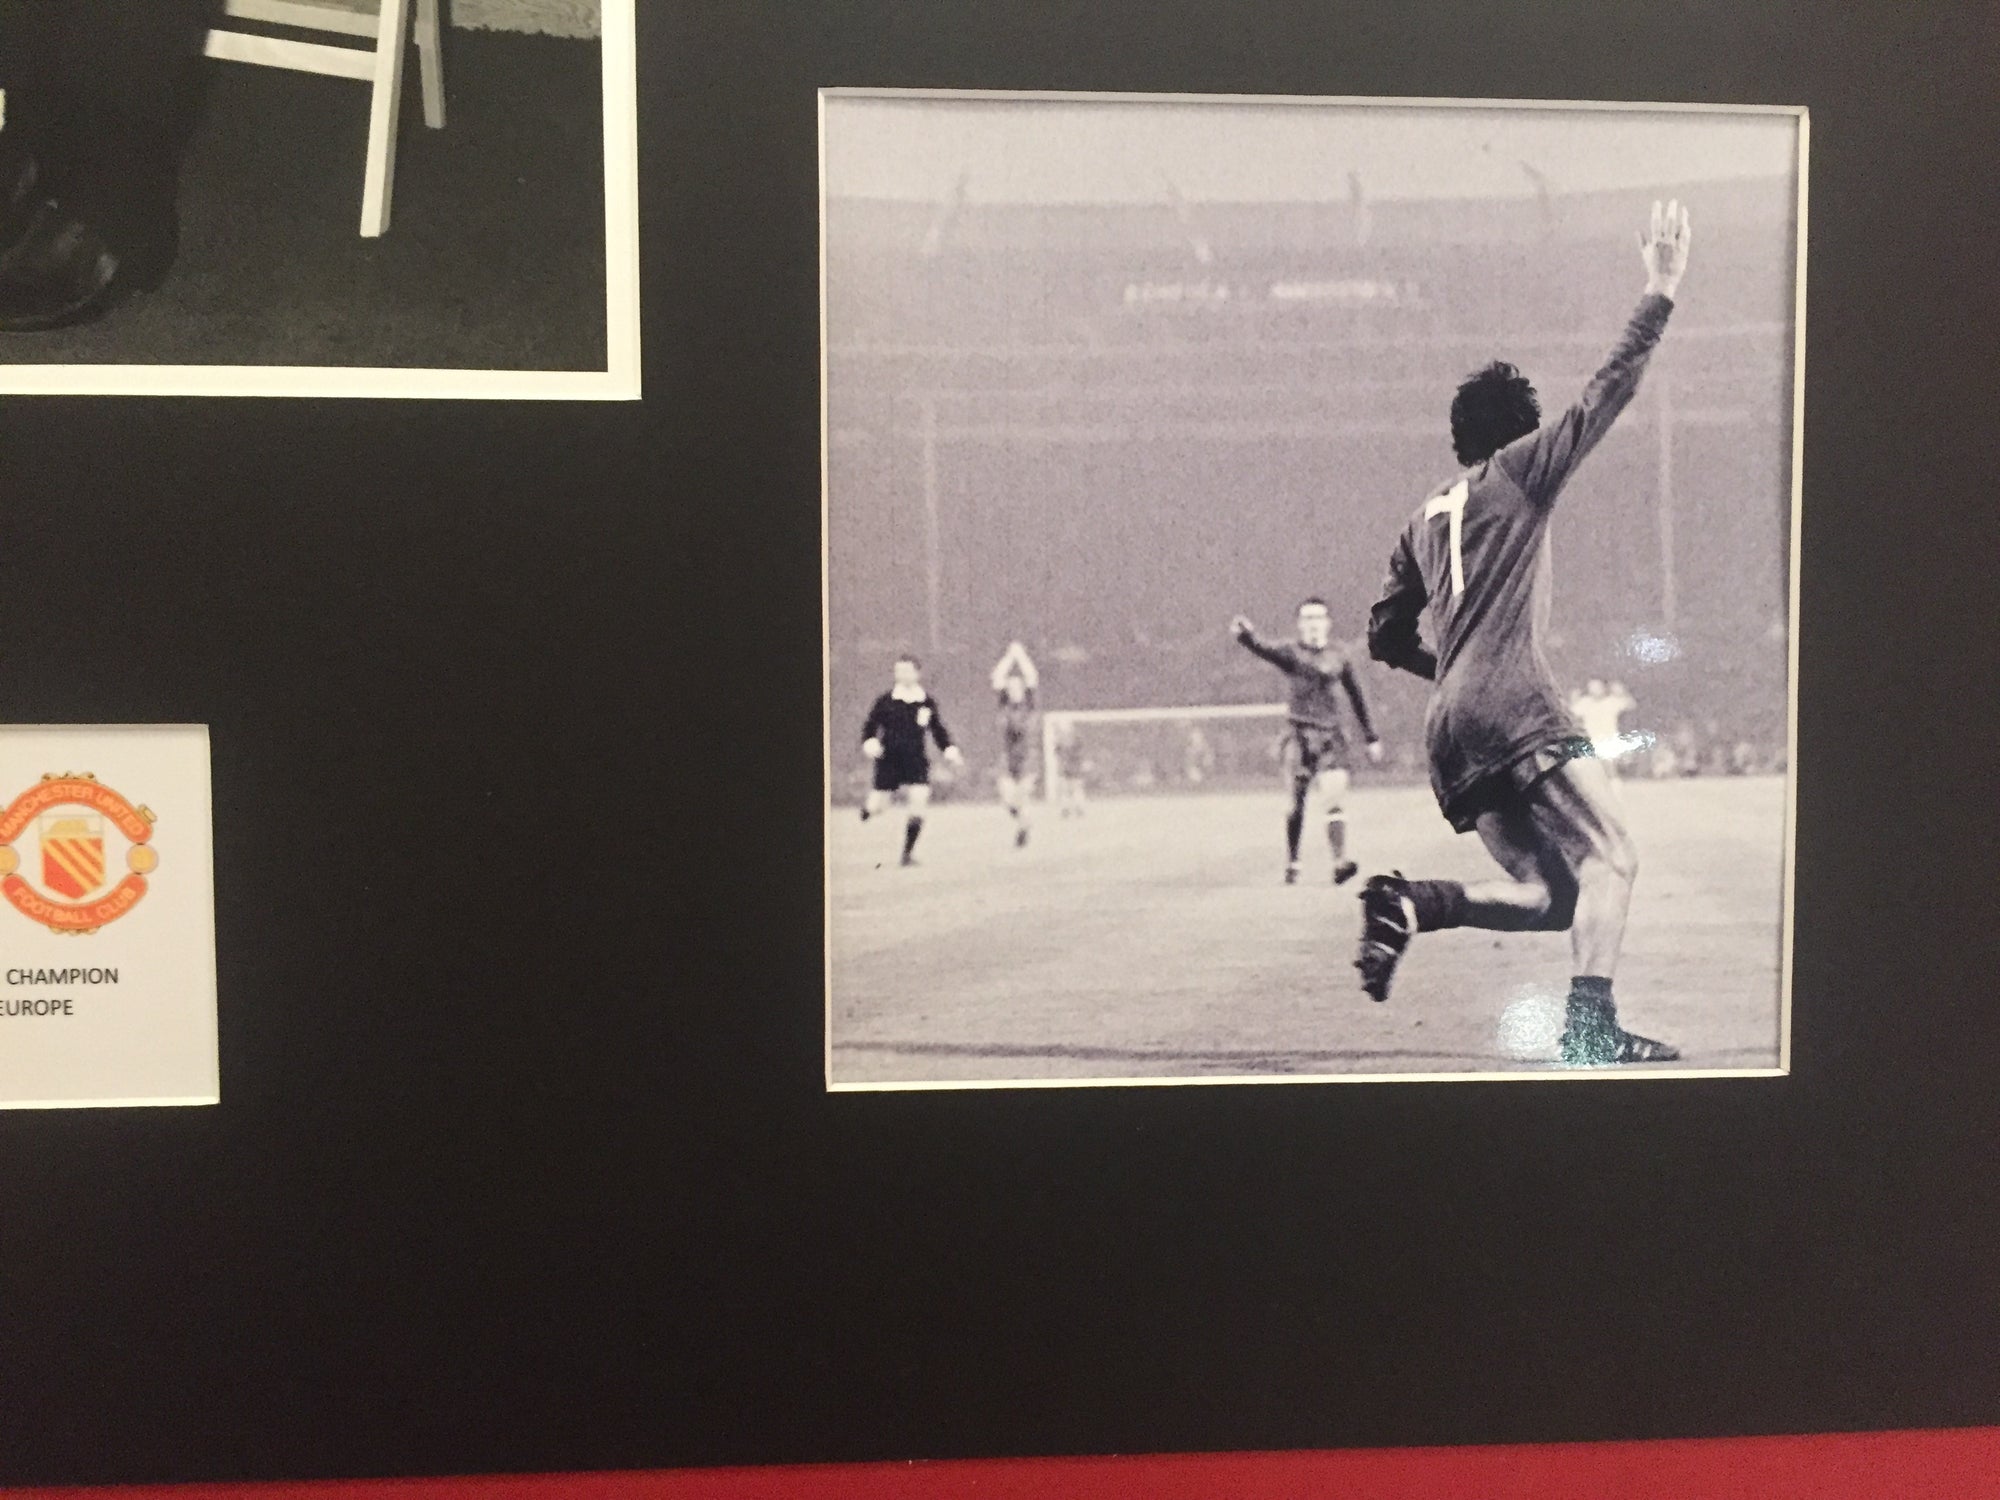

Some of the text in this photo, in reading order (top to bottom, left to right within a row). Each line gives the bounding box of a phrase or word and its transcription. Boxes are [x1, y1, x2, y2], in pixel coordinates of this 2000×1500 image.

[1424, 478, 1468, 597] 7
[0, 786, 145, 837] MANCHESTER UNITED
[13, 886, 137, 923] FOOTBALL CLUB
[6, 968, 118, 985] CHAMPION
